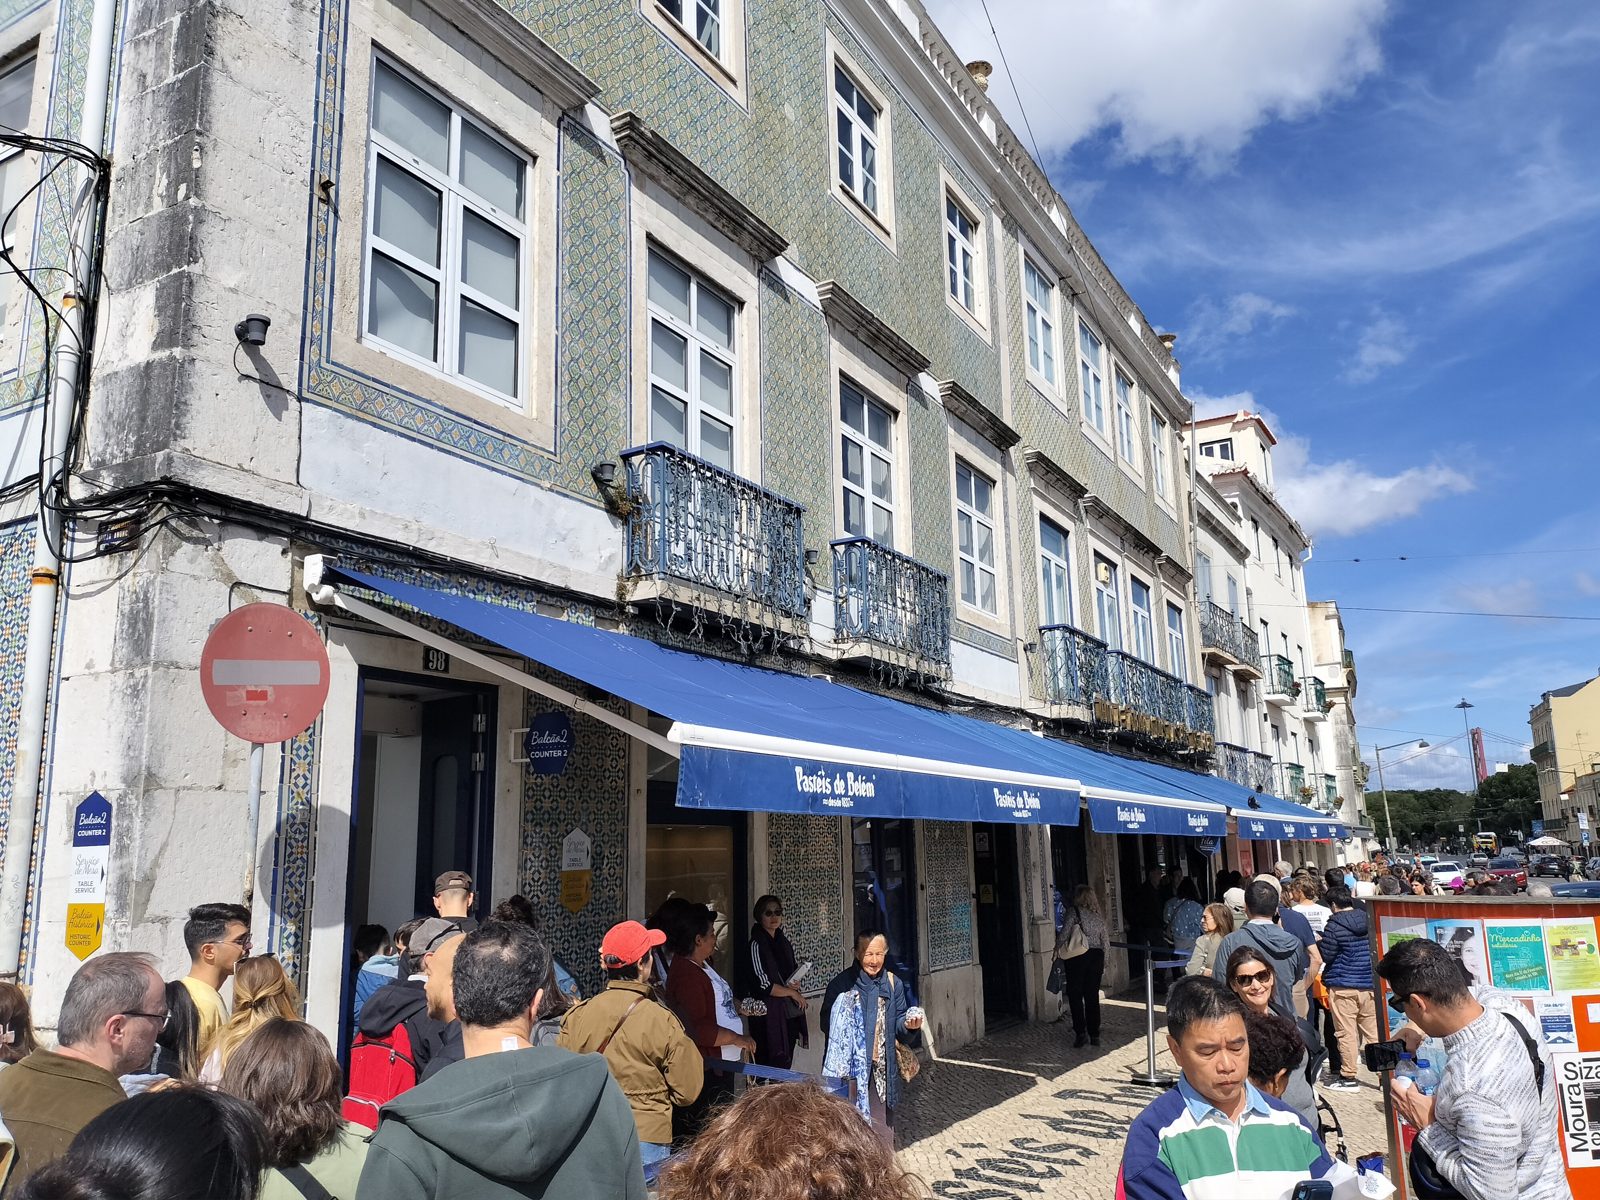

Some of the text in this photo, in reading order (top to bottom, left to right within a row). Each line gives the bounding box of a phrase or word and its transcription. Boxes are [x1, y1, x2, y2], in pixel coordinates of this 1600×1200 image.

[429, 650, 445, 670] 98
[531, 729, 568, 745] Balcão 2
[530, 750, 562, 758] COUNTER
[795, 765, 875, 798] Pastéis de Belém
[101, 812, 107, 824] 2
[1489, 933, 1541, 942] Mercadinho
[1567, 1083, 1590, 1153] Moura
